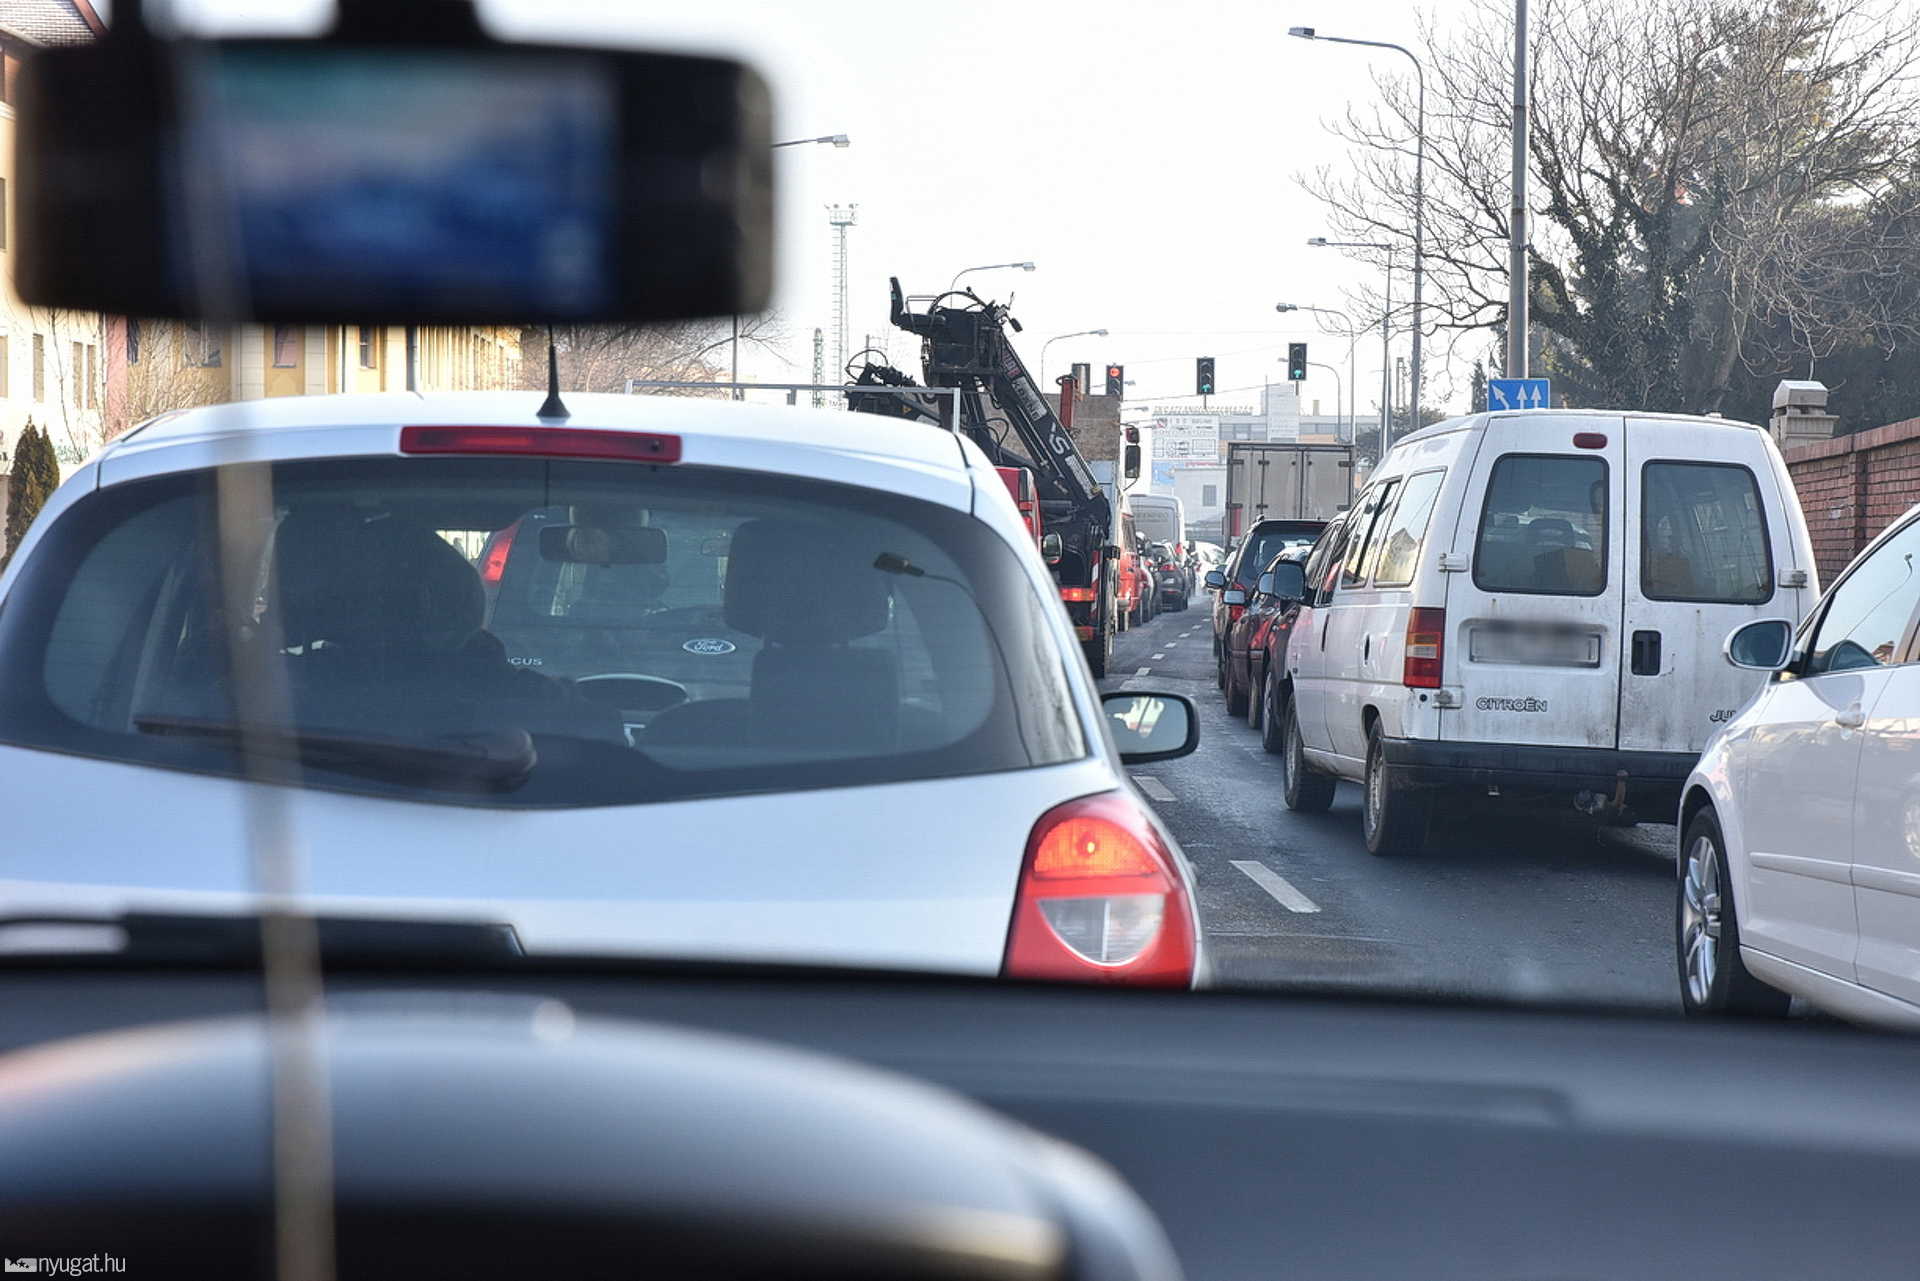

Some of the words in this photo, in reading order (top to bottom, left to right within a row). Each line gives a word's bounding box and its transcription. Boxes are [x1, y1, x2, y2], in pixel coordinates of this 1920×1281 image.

[692, 639, 725, 653] Ford
[1475, 697, 1548, 713] CITROËN
[1709, 710, 1737, 723] JU
